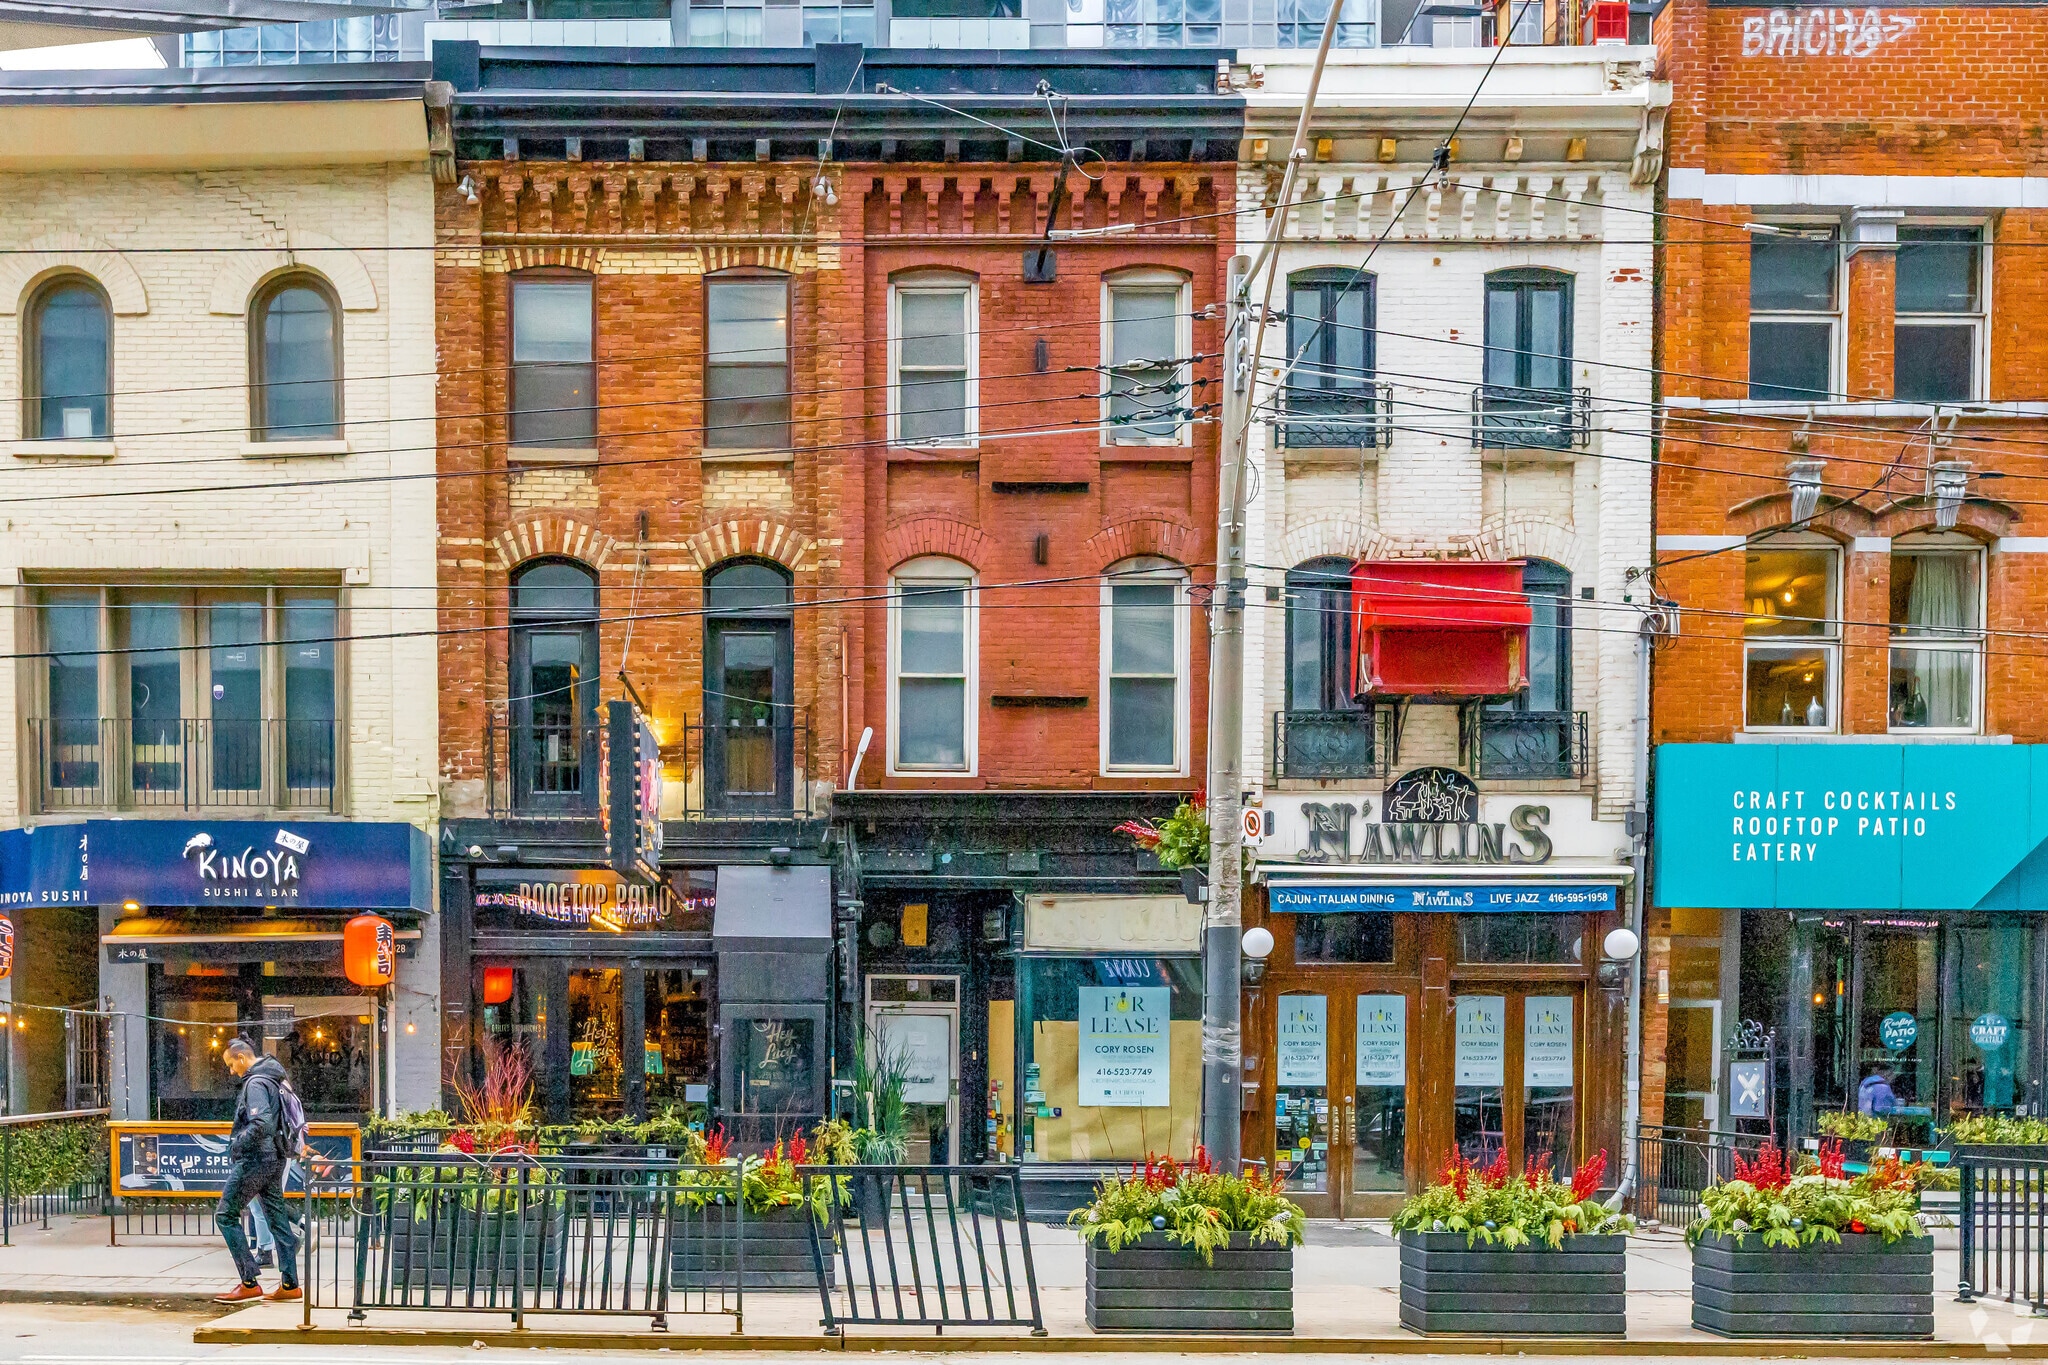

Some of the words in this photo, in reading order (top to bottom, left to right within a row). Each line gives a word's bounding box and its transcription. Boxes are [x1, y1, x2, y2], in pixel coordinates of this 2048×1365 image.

[1732, 790, 1806, 811] CRAFT
[1823, 790, 1957, 811] COCKTAILS
[1732, 816, 1839, 836] ROOFTOP
[1858, 817, 1927, 837] PATIO
[1732, 842, 1818, 862] EATERY
[199, 845, 301, 886] KINOYA
[41, 890, 88, 902] SUSHI
[203, 888, 248, 897] SUSHI
[255, 888, 263, 897] &
[271, 888, 299, 897] BAR
[1489, 894, 1512, 903] LIVE
[1514, 893, 1540, 903] JAZZ
[519, 882, 607, 915] ROOFTOP
[615, 883, 672, 916] PATIO
[1277, 894, 1311, 904] CAJUN
[1318, 893, 1357, 904] ITALIAN
[1359, 893, 1395, 904] DINING
[1104, 992, 1145, 1013] FOR
[1091, 1017, 1159, 1033] LEASE
[1283, 1023, 1322, 1034] LEASE
[1362, 1023, 1401, 1033] LEASE
[1461, 1024, 1500, 1034] LEASE
[1529, 1025, 1568, 1035] LEASE
[1971, 1025, 2007, 1035] CRAFT
[1885, 1027, 1915, 1038] PATIO
[1095, 1045, 1120, 1054] CORY
[1123, 1045, 1154, 1054] ROSEN
[1096, 1067, 1153, 1076] 416-523-7749
